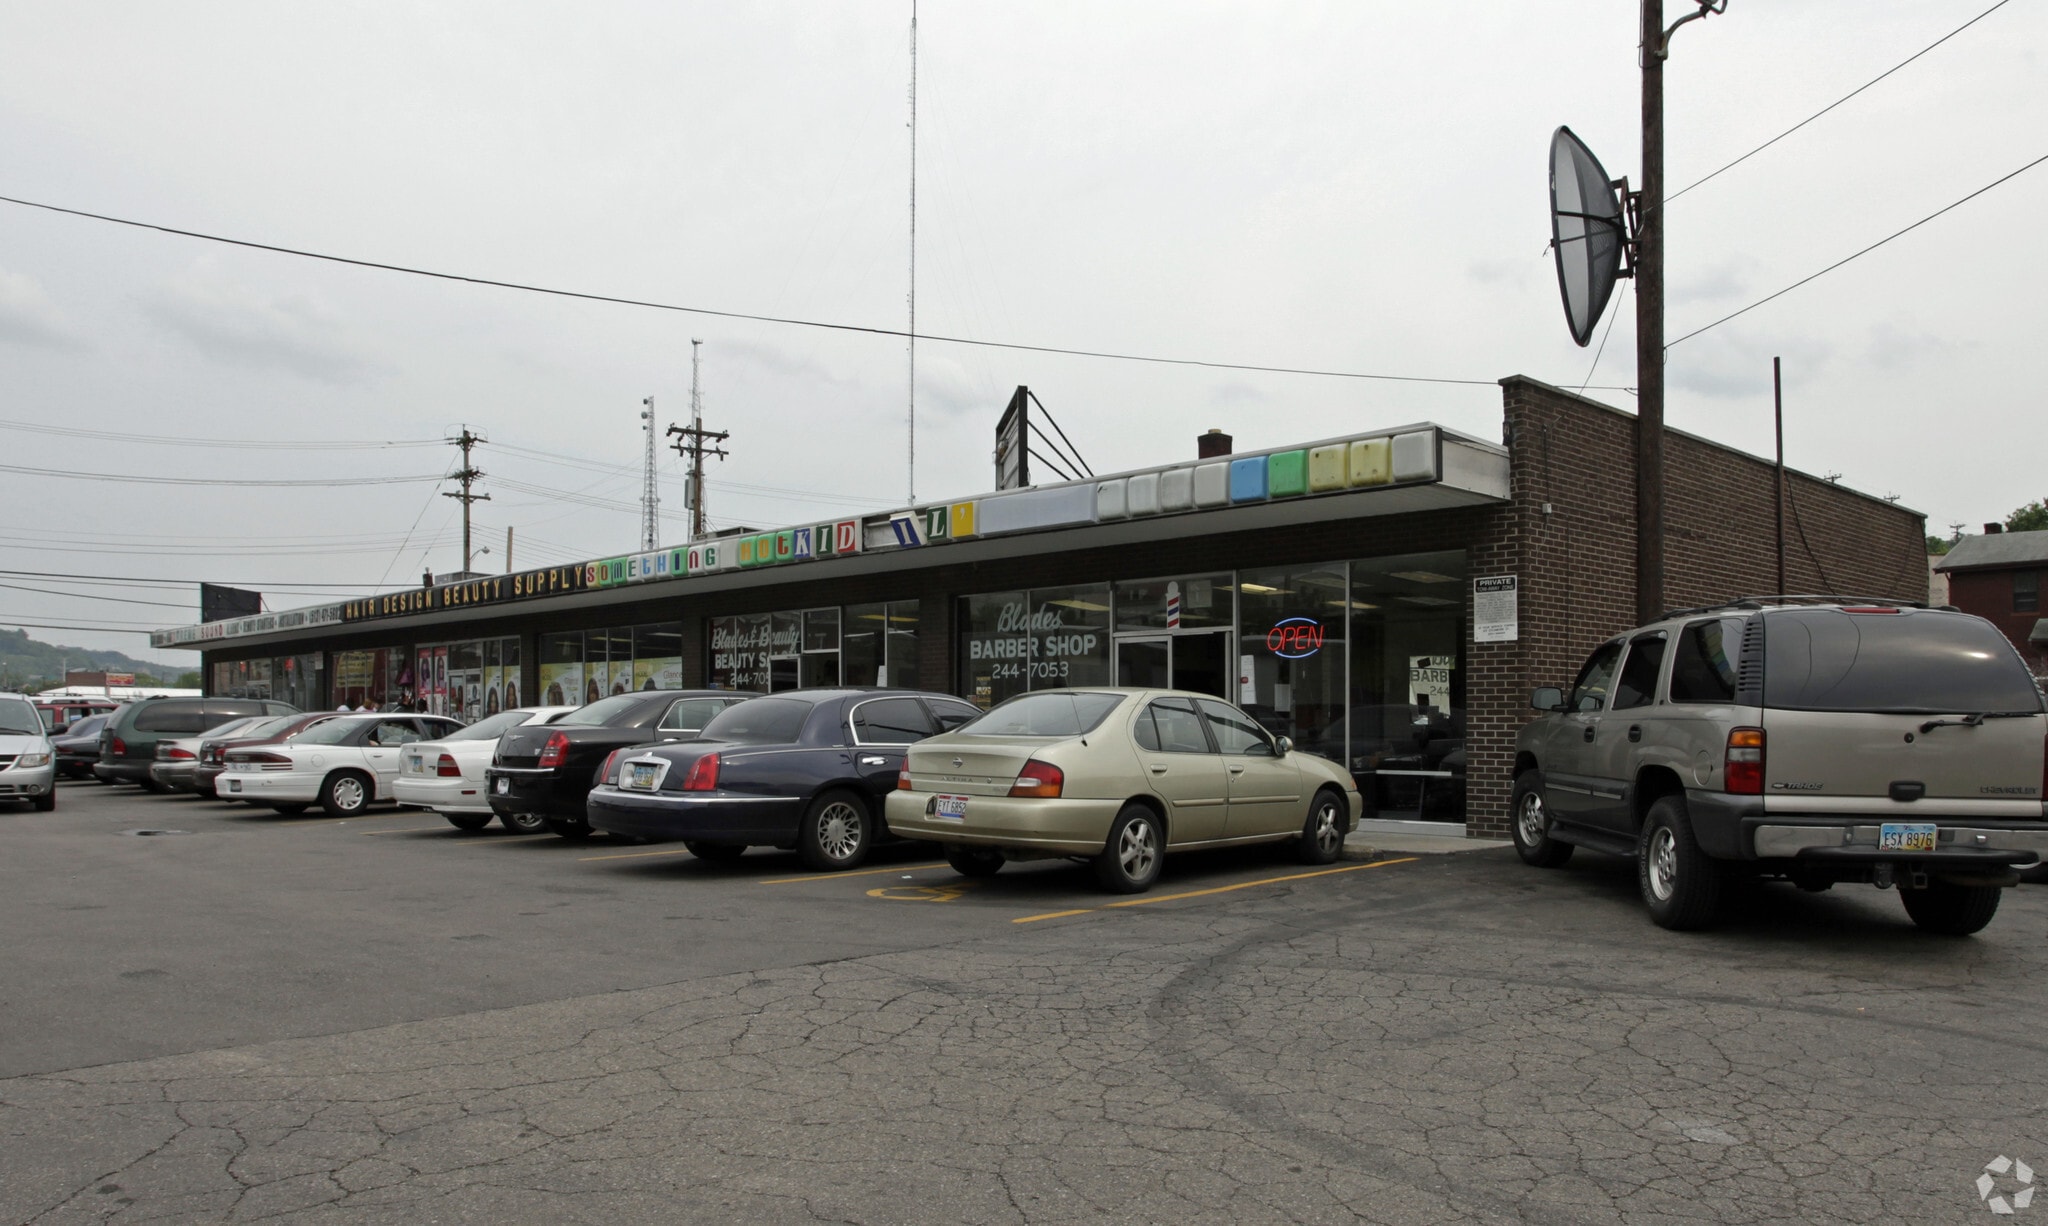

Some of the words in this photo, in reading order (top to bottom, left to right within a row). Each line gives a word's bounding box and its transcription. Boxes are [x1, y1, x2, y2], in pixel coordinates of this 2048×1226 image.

[1480, 578, 1511, 586] PRIVATE
[346, 599, 375, 619] HAIR
[384, 588, 432, 613] DESIGN
[444, 579, 499, 605] BEAUTY
[514, 566, 582, 595] SUPPLY
[998, 602, 1063, 632] Blades
[970, 637, 1039, 659] BARBER
[1045, 634, 1097, 657] SHOP
[1267, 625, 1324, 651] OPEN
[715, 652, 755, 669] BEAUTY
[992, 661, 1069, 679] 244-7053
[1787, 782, 1824, 790] TAHOE
[938, 800, 950, 812] EYT
[951, 801, 967, 814] 6852
[1884, 832, 1903, 846] ESX
[1906, 832, 1933, 847] 8976
